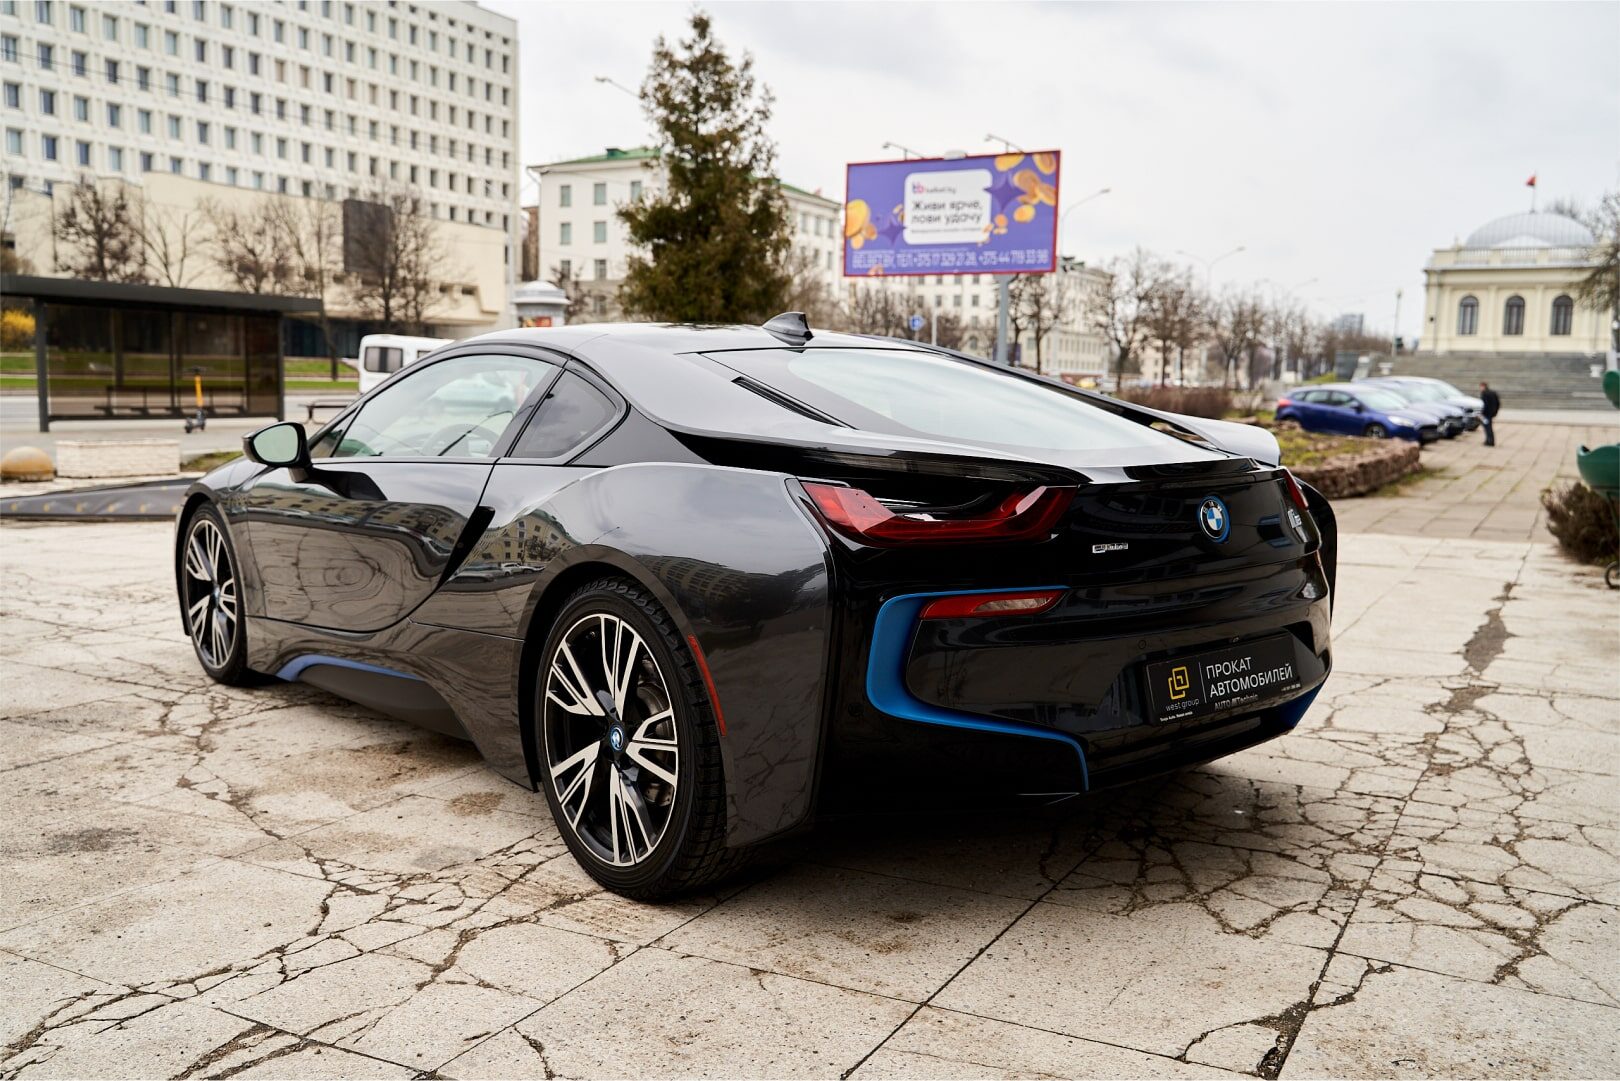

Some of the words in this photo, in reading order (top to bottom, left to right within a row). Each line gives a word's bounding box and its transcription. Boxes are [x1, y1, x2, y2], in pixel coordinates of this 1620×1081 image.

[913, 201, 946, 211] Живи
[949, 200, 983, 212] ярче,
[912, 214, 941, 224] лови
[944, 213, 982, 226] удачу
[1206, 656, 1252, 679] ПРОКАТ
[1209, 663, 1293, 698] АВТОМОБИЛЕЙ
[1165, 702, 1181, 712] west
[1181, 698, 1200, 710] group
